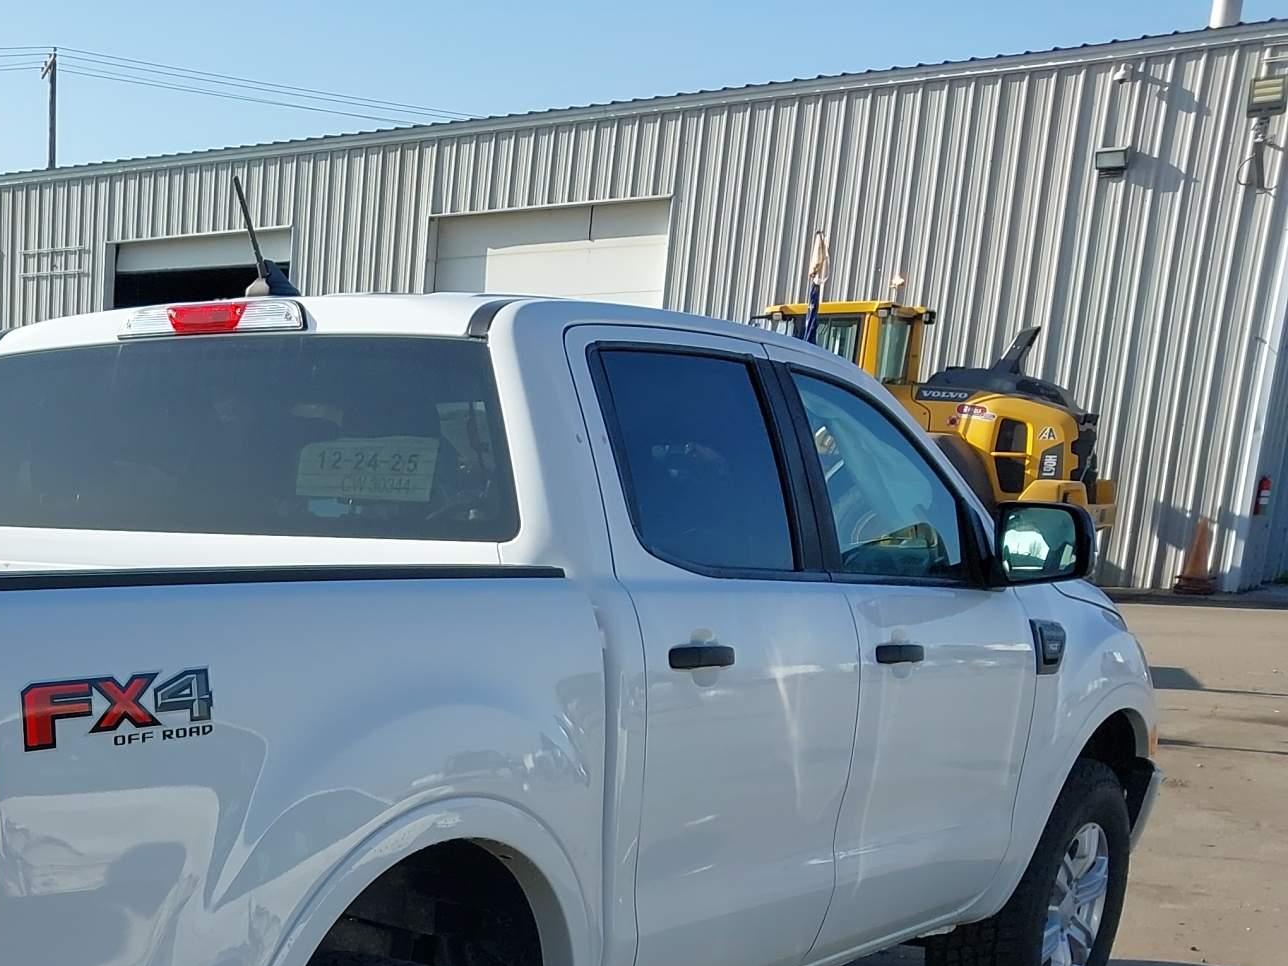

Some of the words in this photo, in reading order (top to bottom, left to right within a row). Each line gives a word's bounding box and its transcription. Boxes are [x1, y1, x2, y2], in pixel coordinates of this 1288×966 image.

[921, 390, 969, 399] VOLVO
[318, 451, 418, 472] 12-24-25
[1042, 455, 1058, 476] L90H
[21, 667, 213, 752] FX4
[114, 731, 154, 746] OFF
[162, 724, 214, 741] ROAD
